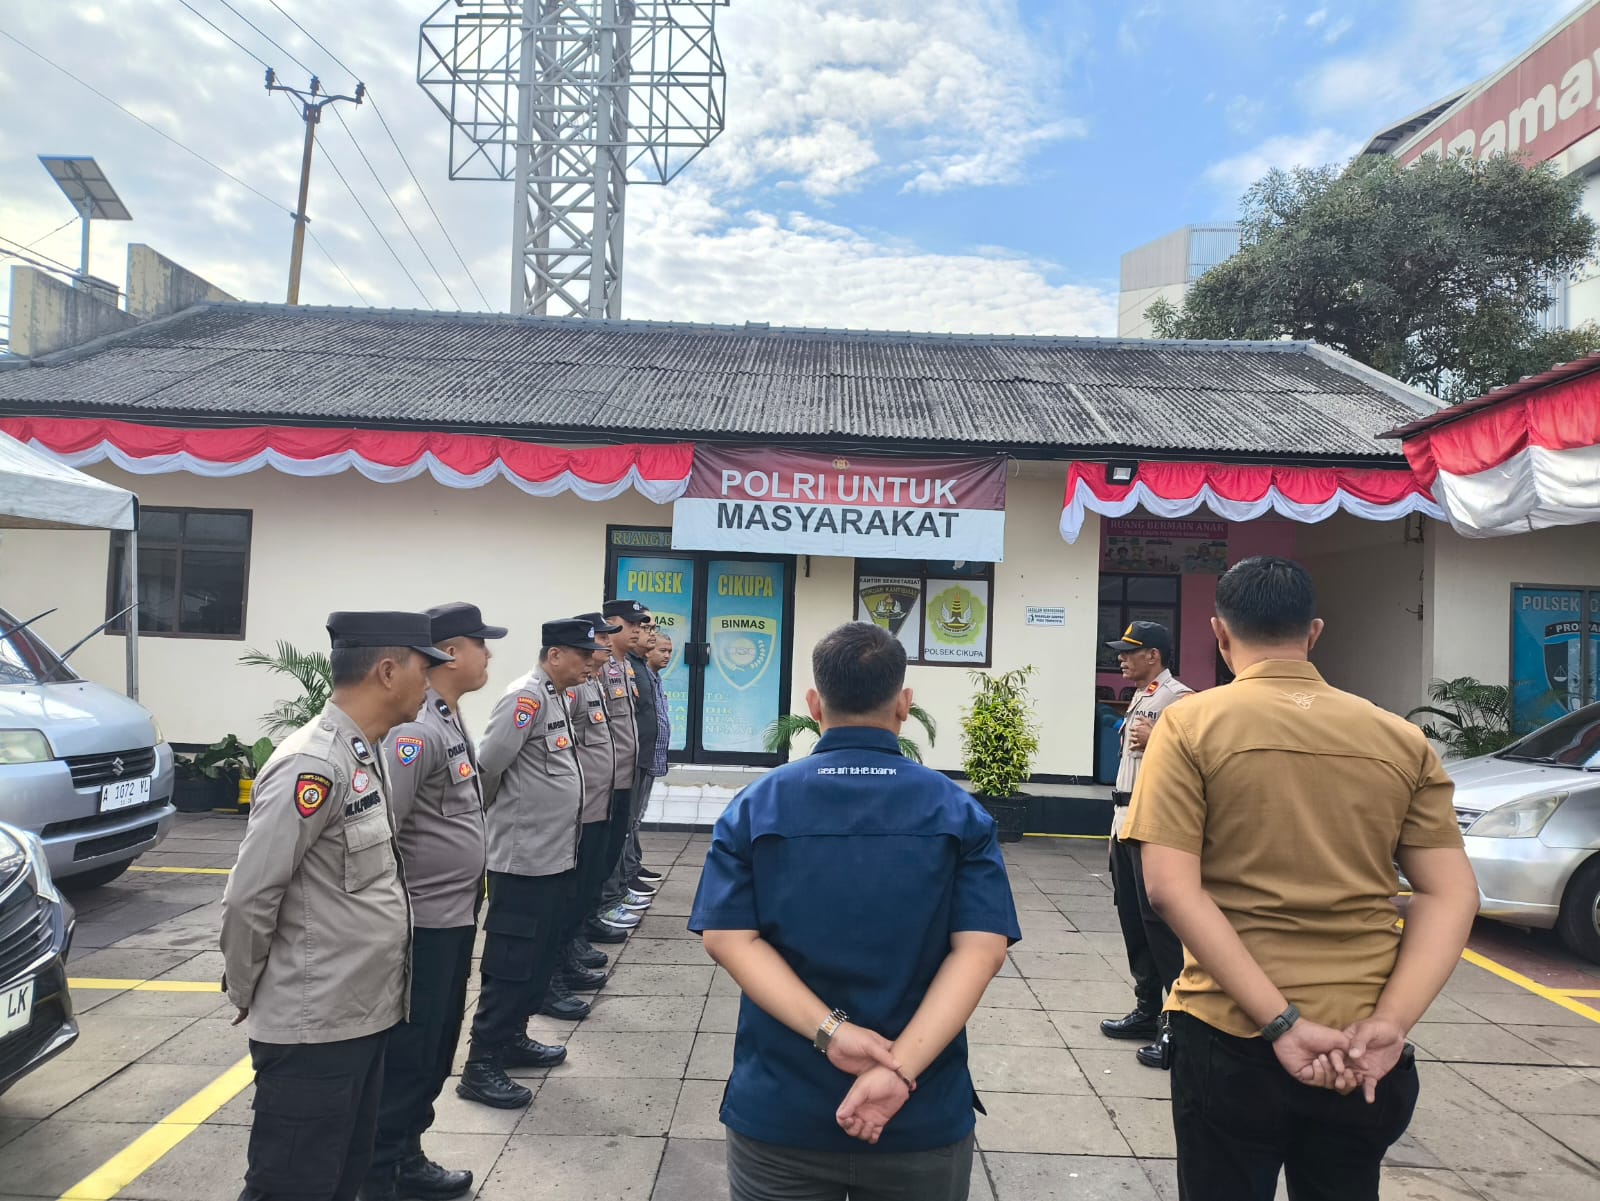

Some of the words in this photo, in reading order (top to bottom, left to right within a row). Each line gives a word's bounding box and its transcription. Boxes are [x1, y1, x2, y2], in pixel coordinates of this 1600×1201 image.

[720, 469, 825, 500] POLRI
[837, 475, 958, 505] UNTUK
[717, 503, 960, 538] MASYARAKAT
[1111, 520, 1145, 529] RUANG
[1147, 521, 1196, 530] BERMAIN
[1197, 522, 1225, 532] ANAK
[613, 532, 659, 546] RUANG
[628, 570, 683, 594] POLSEK
[717, 574, 774, 597] CIKUPA
[1522, 595, 1579, 611] POLSEK
[721, 618, 766, 630] BINMAS
[924, 648, 954, 656] POLSEK
[956, 649, 984, 658] CIKUPA
[103, 787, 108, 802] A
[115, 782, 135, 799] 1072
[8, 986, 28, 1018] LK
